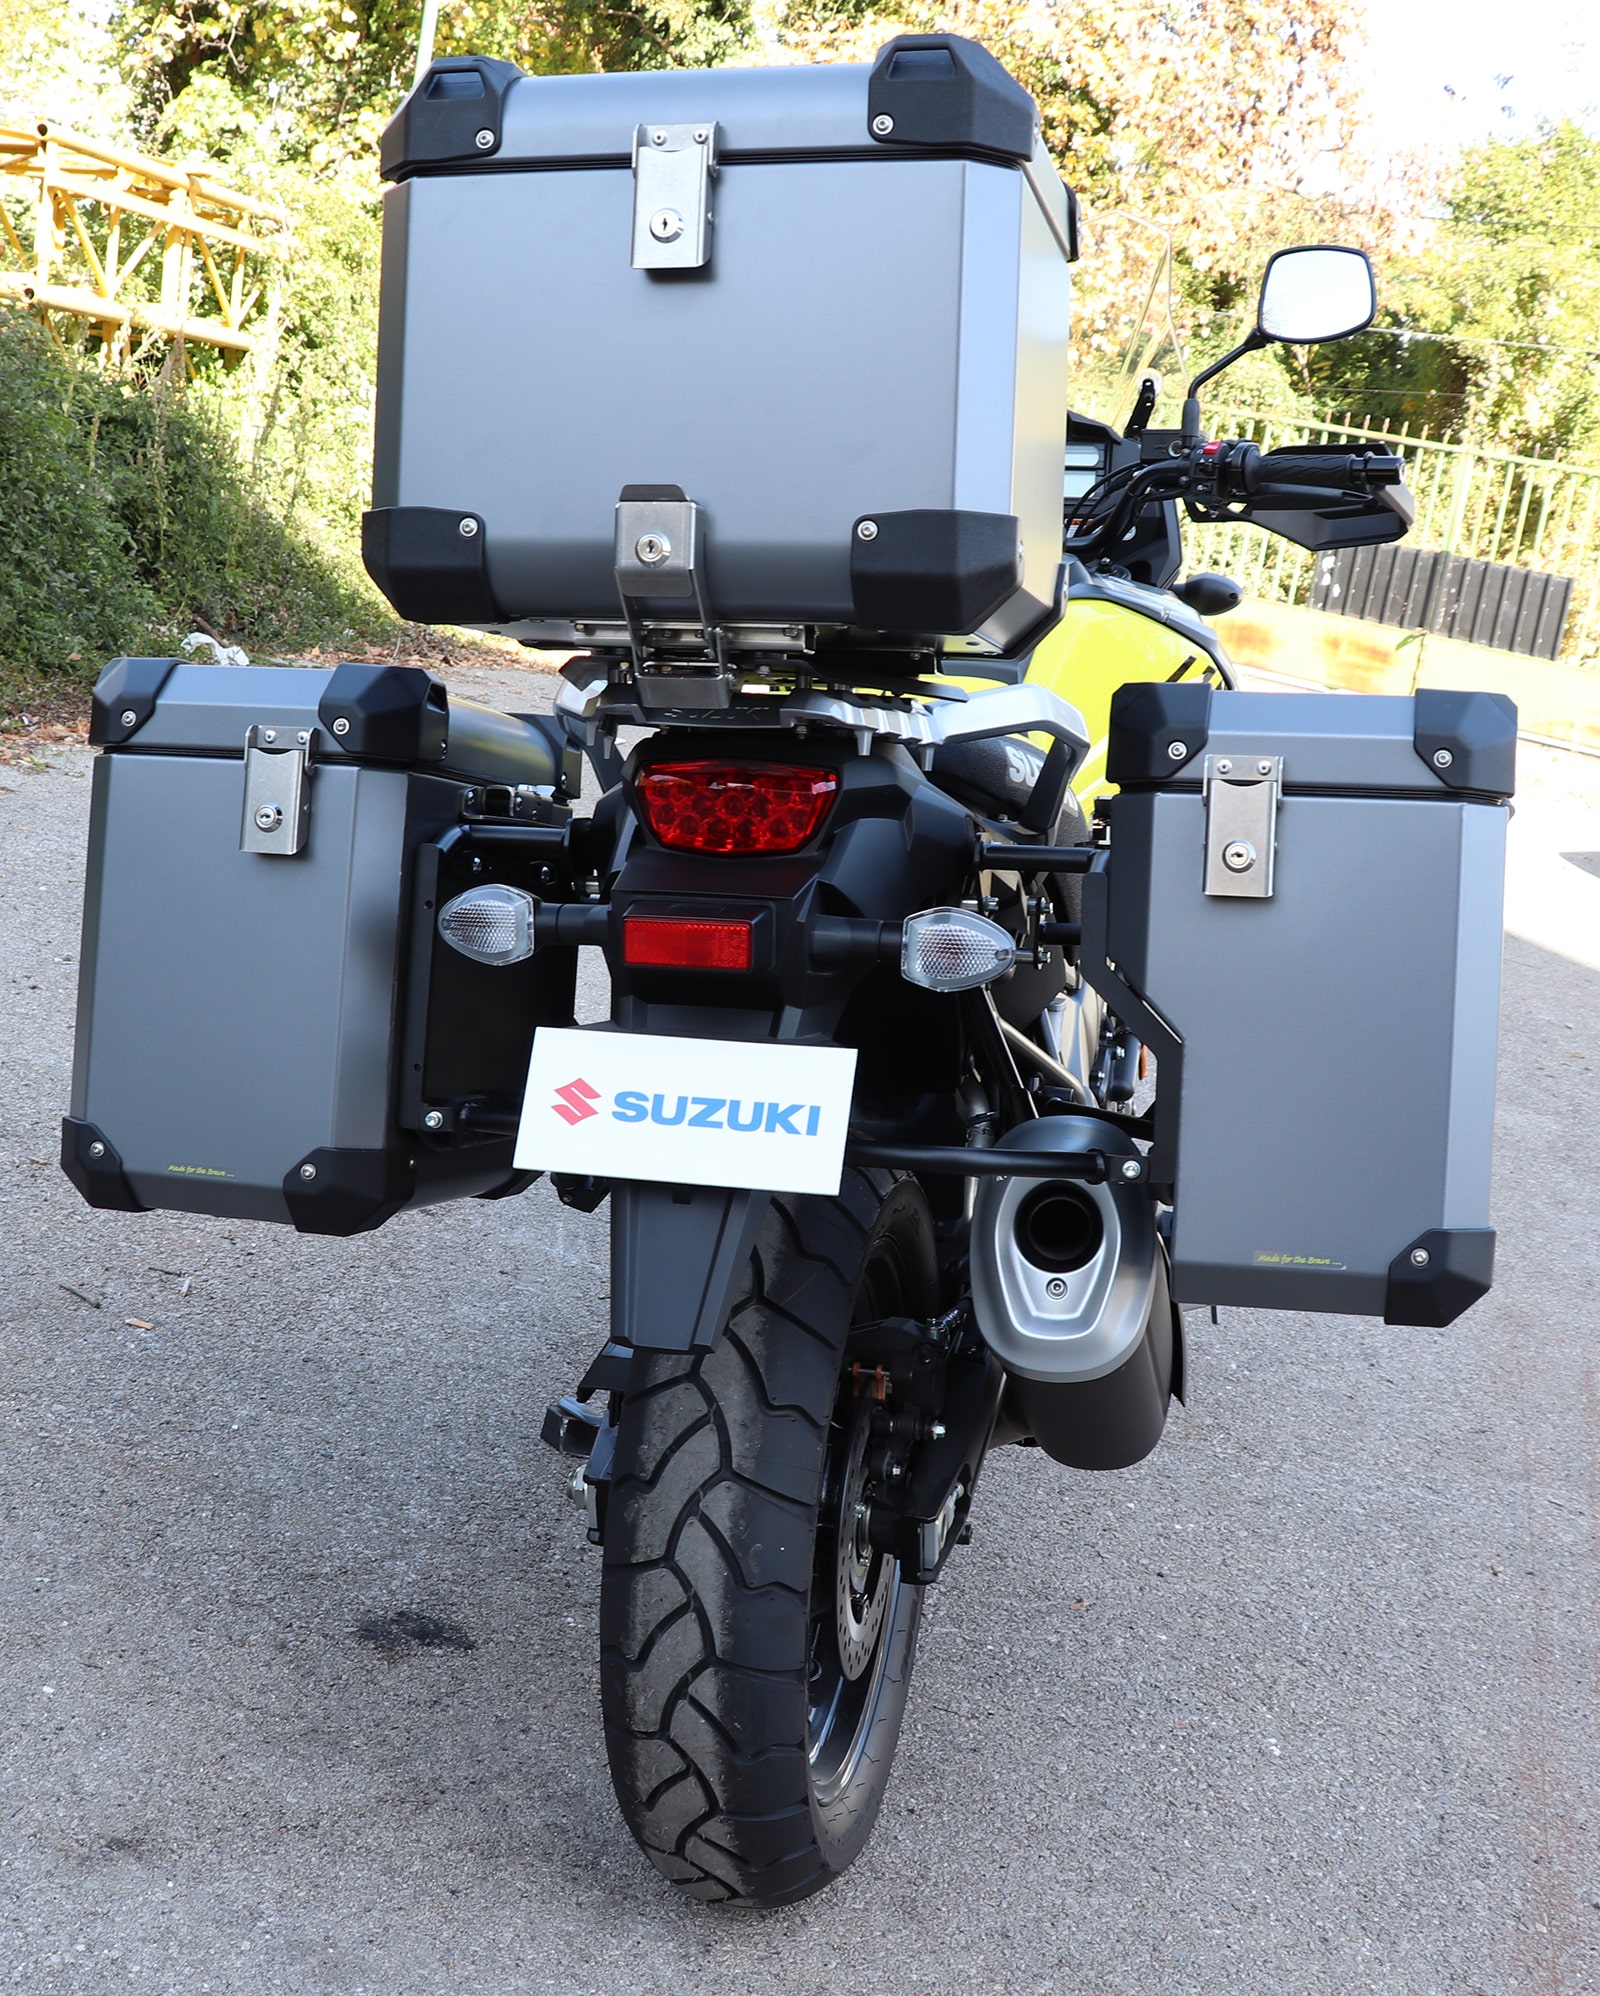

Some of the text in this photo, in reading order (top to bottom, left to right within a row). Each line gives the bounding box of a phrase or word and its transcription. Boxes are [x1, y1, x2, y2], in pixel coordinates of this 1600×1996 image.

[611, 1090, 822, 1137] SUZUKI
[186, 1165, 196, 1174] for
[1258, 1254, 1280, 1262] Made
[1281, 1254, 1293, 1264] for
[1294, 1255, 1306, 1263] the
